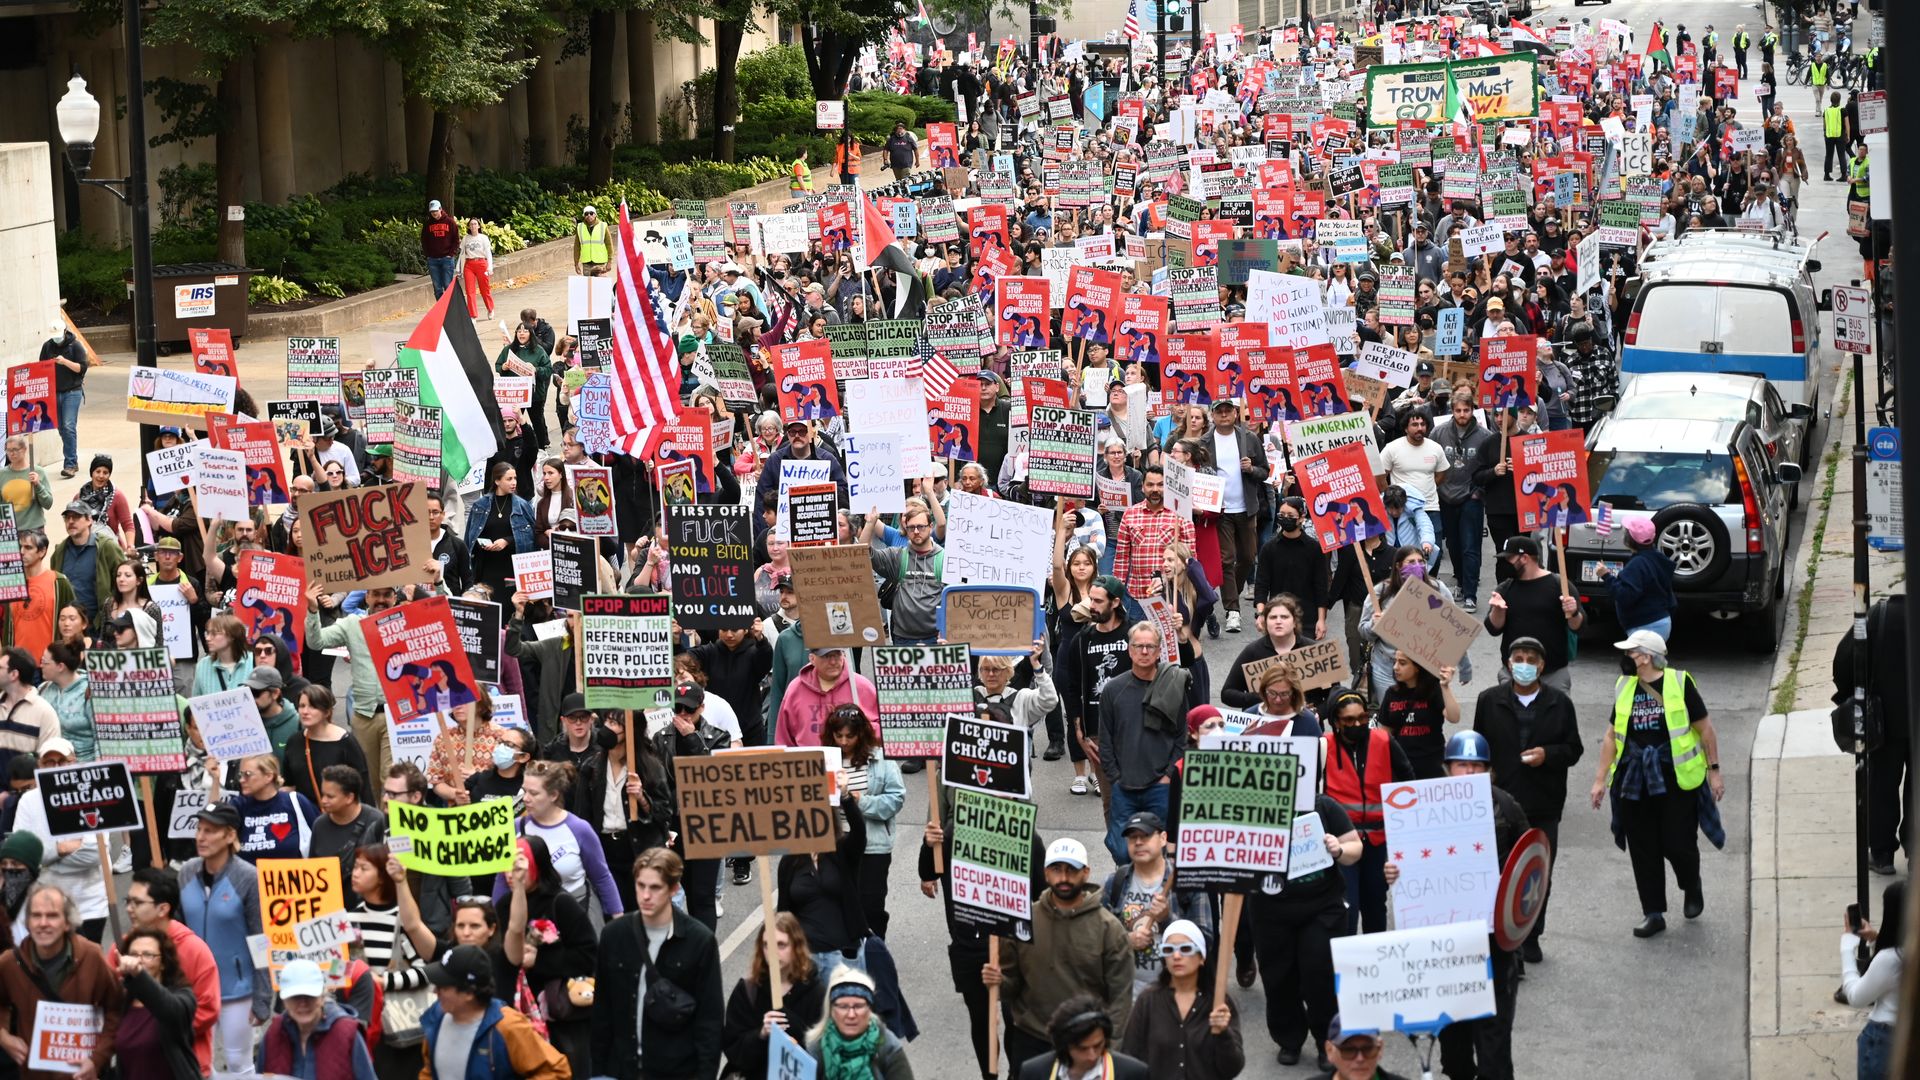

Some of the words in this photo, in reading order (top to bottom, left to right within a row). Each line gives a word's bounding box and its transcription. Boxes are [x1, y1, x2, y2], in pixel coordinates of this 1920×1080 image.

[1469, 78, 1513, 96] Must
[1396, 103, 1432, 120] GO
[1623, 137, 1649, 155] FCK
[1623, 154, 1649, 173] ICE
[1602, 206, 1638, 218] CHICAGO
[1601, 219, 1637, 229] PALESTINE
[1466, 234, 1501, 244] CHICAGO
[191, 287, 213, 299] IRS
[1271, 293, 1288, 304] NO
[1291, 289, 1310, 301] ICE
[1273, 310, 1286, 320] NO
[1288, 304, 1318, 318] GUARD
[1444, 314, 1458, 322] ICE
[1275, 326, 1287, 336] NO
[1291, 319, 1323, 332] TRUMP
[1443, 322, 1457, 330] OUT
[1849, 319, 1861, 329] BUS
[1442, 335, 1456, 344] CHI
[1849, 330, 1865, 340] STOP
[1373, 345, 1386, 353] ICE
[1388, 349, 1407, 360] OUT
[1836, 341, 1848, 350] TOW
[1852, 344, 1867, 352] ZONE
[1365, 355, 1410, 373] CHICAGO
[1302, 417, 1366, 438] IMMIGRANTS
[1298, 441, 1324, 458] MAKE
[1329, 434, 1372, 452] AMERICA
[1523, 446, 1546, 458] STOP
[1877, 441, 1894, 449] cta
[200, 452, 237, 462] STANDING
[1524, 451, 1576, 465] DEPORTATIONS
[202, 462, 239, 470] TOGETHER
[848, 462, 895, 479] Civics
[1543, 461, 1576, 471] DEFEND
[1526, 469, 1577, 483] IMMIGRANTS
[200, 484, 246, 498] STRONGER!
[850, 484, 902, 496] Education
[807, 496, 821, 504] DOWN
[823, 494, 834, 502] ICE!
[309, 481, 417, 546] FUCK
[671, 506, 713, 517] FIRST
[719, 506, 746, 516] OFF
[806, 503, 828, 512] MILITARY
[797, 511, 829, 519] OCCUPATION!
[682, 520, 738, 544] FUCK
[347, 525, 409, 581] ICE
[553, 543, 565, 552] THE
[567, 544, 581, 554] FALL
[671, 546, 708, 558] YOUR
[717, 544, 748, 561] BITCH
[821, 548, 868, 560] INJUSTICE
[310, 551, 323, 562] NO
[324, 552, 352, 564] HUMAN
[554, 558, 578, 569] TRUMP
[313, 569, 322, 578] IS
[554, 567, 581, 578] FASCIST
[672, 564, 701, 575] AND
[712, 565, 739, 575] THE
[555, 575, 582, 586] REGIME
[803, 575, 863, 587] RESISTANCE
[683, 578, 737, 598] CLIQUE
[585, 599, 624, 614] CPOP
[630, 599, 667, 613] NOW!
[952, 596, 986, 609] USE
[993, 595, 1026, 608] YOUR
[676, 604, 703, 615] YOU
[710, 604, 753, 616] CLAIM
[968, 609, 1017, 622] VOICE!
[378, 620, 406, 637] STOP
[585, 619, 638, 630] SUPPORT
[643, 619, 667, 629] THE
[382, 621, 444, 648] DEPORTATIONS
[586, 631, 668, 644] REFERENDUM
[406, 632, 447, 652] DEFEND
[586, 644, 601, 652] FOR
[1088, 641, 1128, 655] languid
[389, 643, 451, 666] IMMIGRANTS
[587, 653, 619, 665] OVER
[624, 653, 669, 665] POLICE
[877, 651, 924, 667] STOP
[929, 648, 965, 664] THE
[877, 666, 915, 676] TRUMP
[919, 664, 968, 674] AGENDA!
[934, 674, 972, 682] EXPAND
[878, 682, 934, 690] IMMIGRANT
[194, 702, 208, 711] WE
[214, 698, 238, 708] HAVE
[242, 693, 249, 702] A
[908, 704, 939, 712] POLICE
[207, 707, 242, 721] RIGHT
[208, 729, 258, 745] DOMESTIC
[959, 723, 981, 737] ICE
[984, 728, 1009, 742] OUT
[210, 741, 268, 758] TRANQUILITY
[951, 742, 1018, 765] CHICAGO
[1189, 753, 1220, 764] FROM
[54, 772, 79, 784] ICE
[82, 770, 110, 782] OUT
[679, 765, 744, 783] THOSE
[749, 760, 824, 781] EPSTEIN
[1186, 766, 1292, 792] CHICAGO
[50, 786, 124, 806] CHICAGO
[682, 788, 736, 808] FILES
[744, 784, 796, 804] MUST
[801, 784, 824, 802] BE
[1276, 795, 1289, 806] TO
[398, 807, 429, 832] NO
[438, 805, 508, 836] TROOPS
[1183, 804, 1288, 825] PALESTINE
[1389, 801, 1487, 831] STANDS
[686, 813, 768, 844] REAL
[773, 808, 829, 838] BAD
[1181, 830, 1284, 848] OCCUPATION
[414, 838, 431, 857] IN
[437, 832, 510, 866] CHICAGO!
[1180, 847, 1197, 861] IS
[1204, 847, 1216, 861] A
[1224, 847, 1282, 866] CRIME!
[263, 868, 328, 896] HANDS
[1395, 871, 1492, 900] AGAINST
[269, 898, 321, 925] OFF
[271, 932, 294, 944] OUR
[299, 918, 336, 947] CITY
[1378, 943, 1409, 962] SAY
[1432, 938, 1454, 952] NO
[1358, 964, 1379, 979] NO
[1402, 953, 1487, 972] INCARCERATION
[1408, 972, 1426, 985] OF
[1359, 987, 1430, 1006] IMMIGRANT
[1436, 981, 1486, 996] CHILDREN
